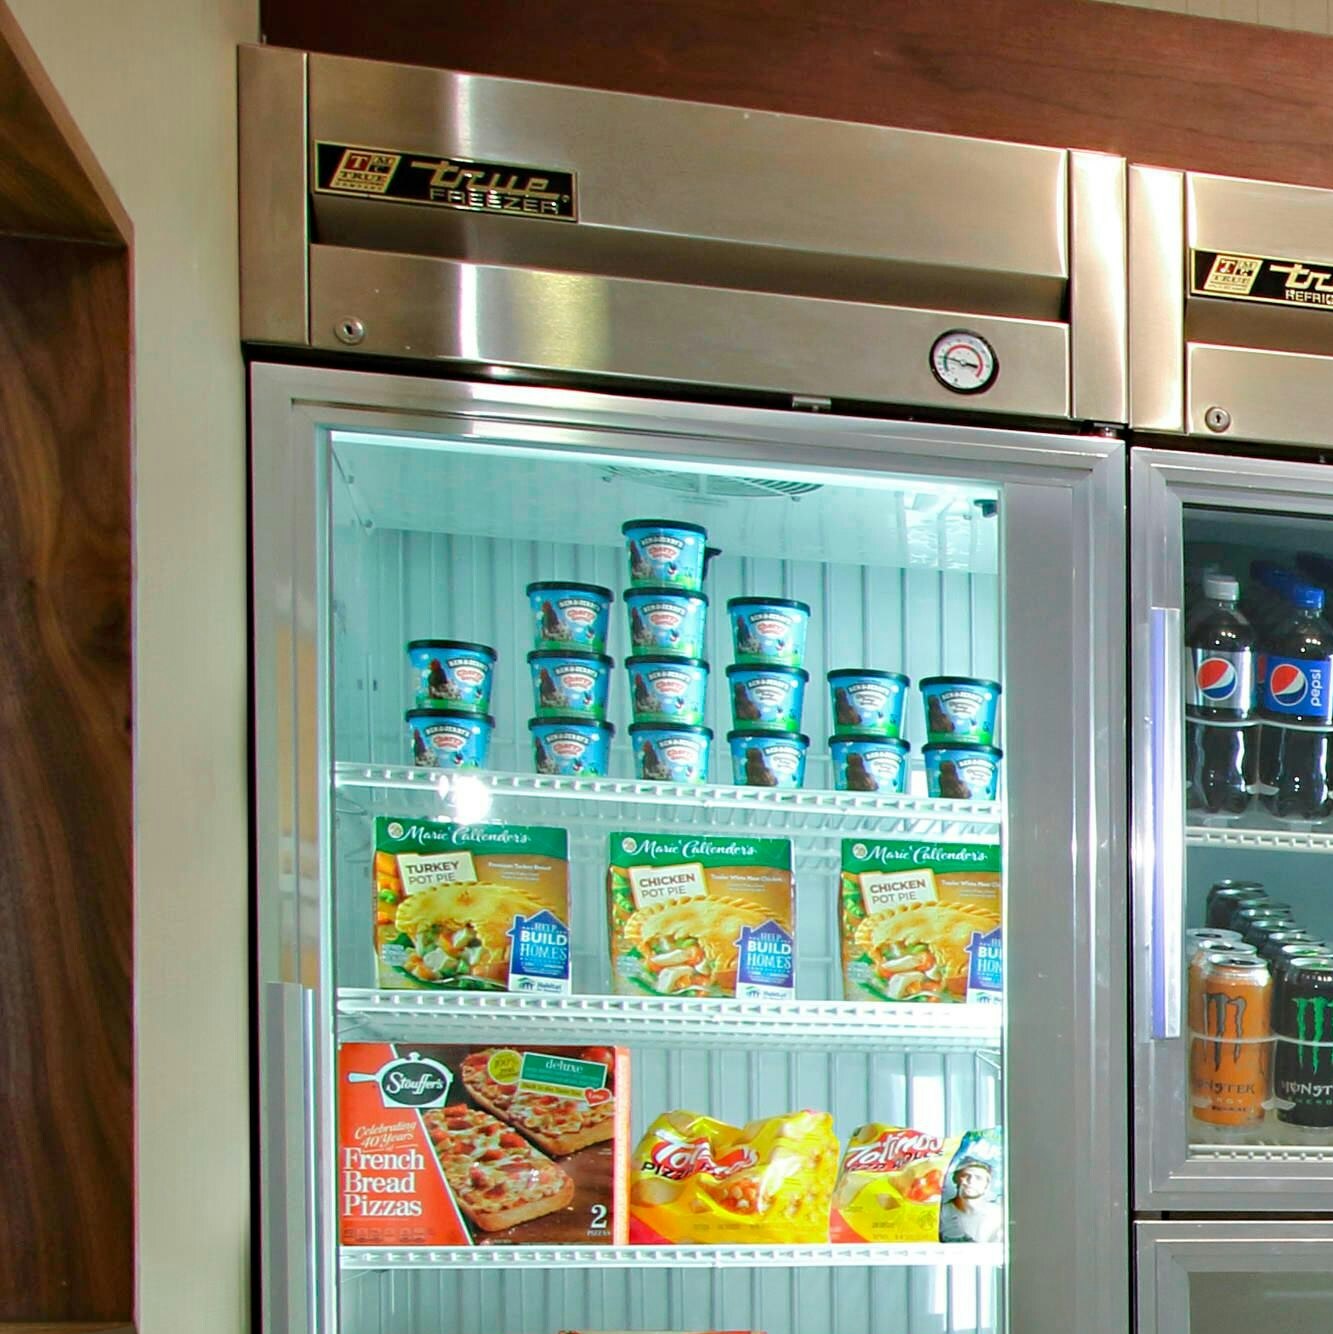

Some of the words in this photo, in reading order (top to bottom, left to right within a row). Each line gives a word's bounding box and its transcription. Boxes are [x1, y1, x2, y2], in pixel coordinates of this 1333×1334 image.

[411, 160, 561, 200] true
[430, 188, 559, 215] FREEZER
[1310, 668, 1323, 708] pepsi
[403, 825, 449, 845] Marie
[452, 824, 531, 845] Callender's
[637, 840, 678, 858] Marie
[682, 838, 757, 857] Callender's
[867, 845, 909, 863] Marie
[913, 844, 988, 863] Callender's
[406, 861, 460, 874] TURKEY
[409, 874, 433, 885] POT
[435, 872, 456, 883] PIE
[639, 873, 695, 888] CHICKEN
[870, 879, 927, 895] CHICKEN
[641, 887, 665, 898] POT
[667, 885, 686, 895] PIE
[872, 893, 898, 905] POT
[899, 891, 916, 902] PIE
[521, 930, 567, 946] BUILD
[520, 945, 567, 961] HOMES
[747, 940, 791, 955] BUILD
[746, 954, 792, 970] HOMES
[545, 1058, 584, 1074] deluxe
[386, 1072, 444, 1095] Stouffer's
[355, 1121, 417, 1139] Celebrating
[344, 1147, 425, 1170] French
[344, 1170, 416, 1194] Bread
[344, 1194, 422, 1217] Pizzas
[590, 1204, 608, 1230] 2
